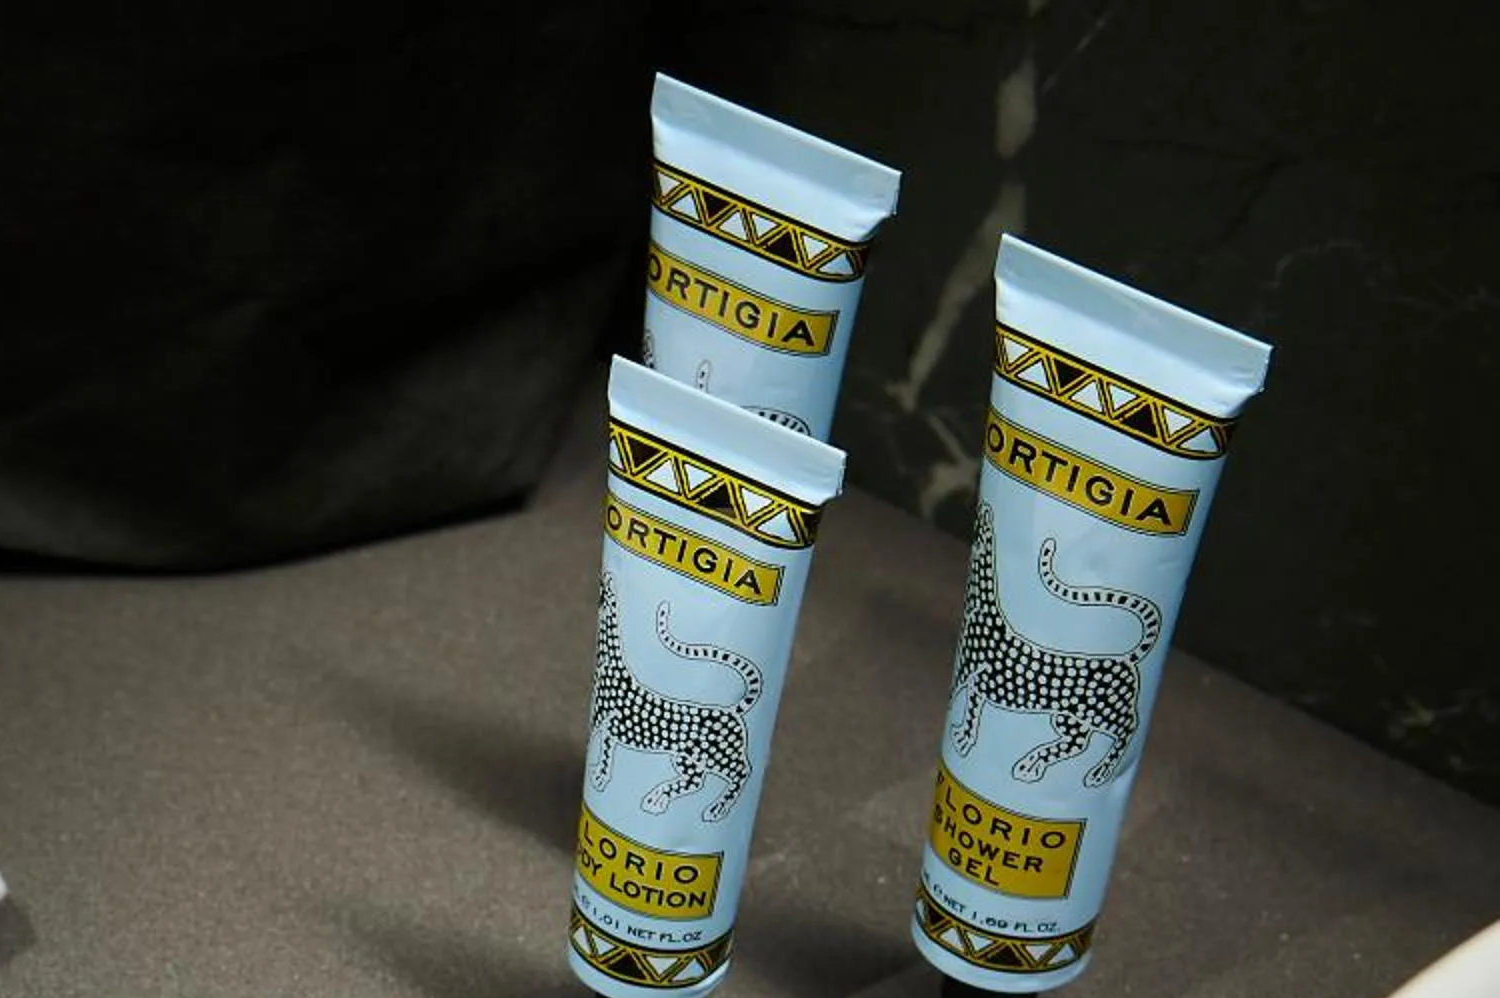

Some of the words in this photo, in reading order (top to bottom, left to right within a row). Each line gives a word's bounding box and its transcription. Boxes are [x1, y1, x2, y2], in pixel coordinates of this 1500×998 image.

[649, 253, 815, 347] ORTIGIA
[987, 423, 1172, 526] ORTIGIA
[607, 505, 762, 595] ORTIGIA
[582, 820, 699, 884] LORIO
[934, 804, 1043, 873] SHOWER
[948, 848, 1000, 886] GEL
[581, 847, 603, 876] DY
[610, 872, 708, 909] LOTION
